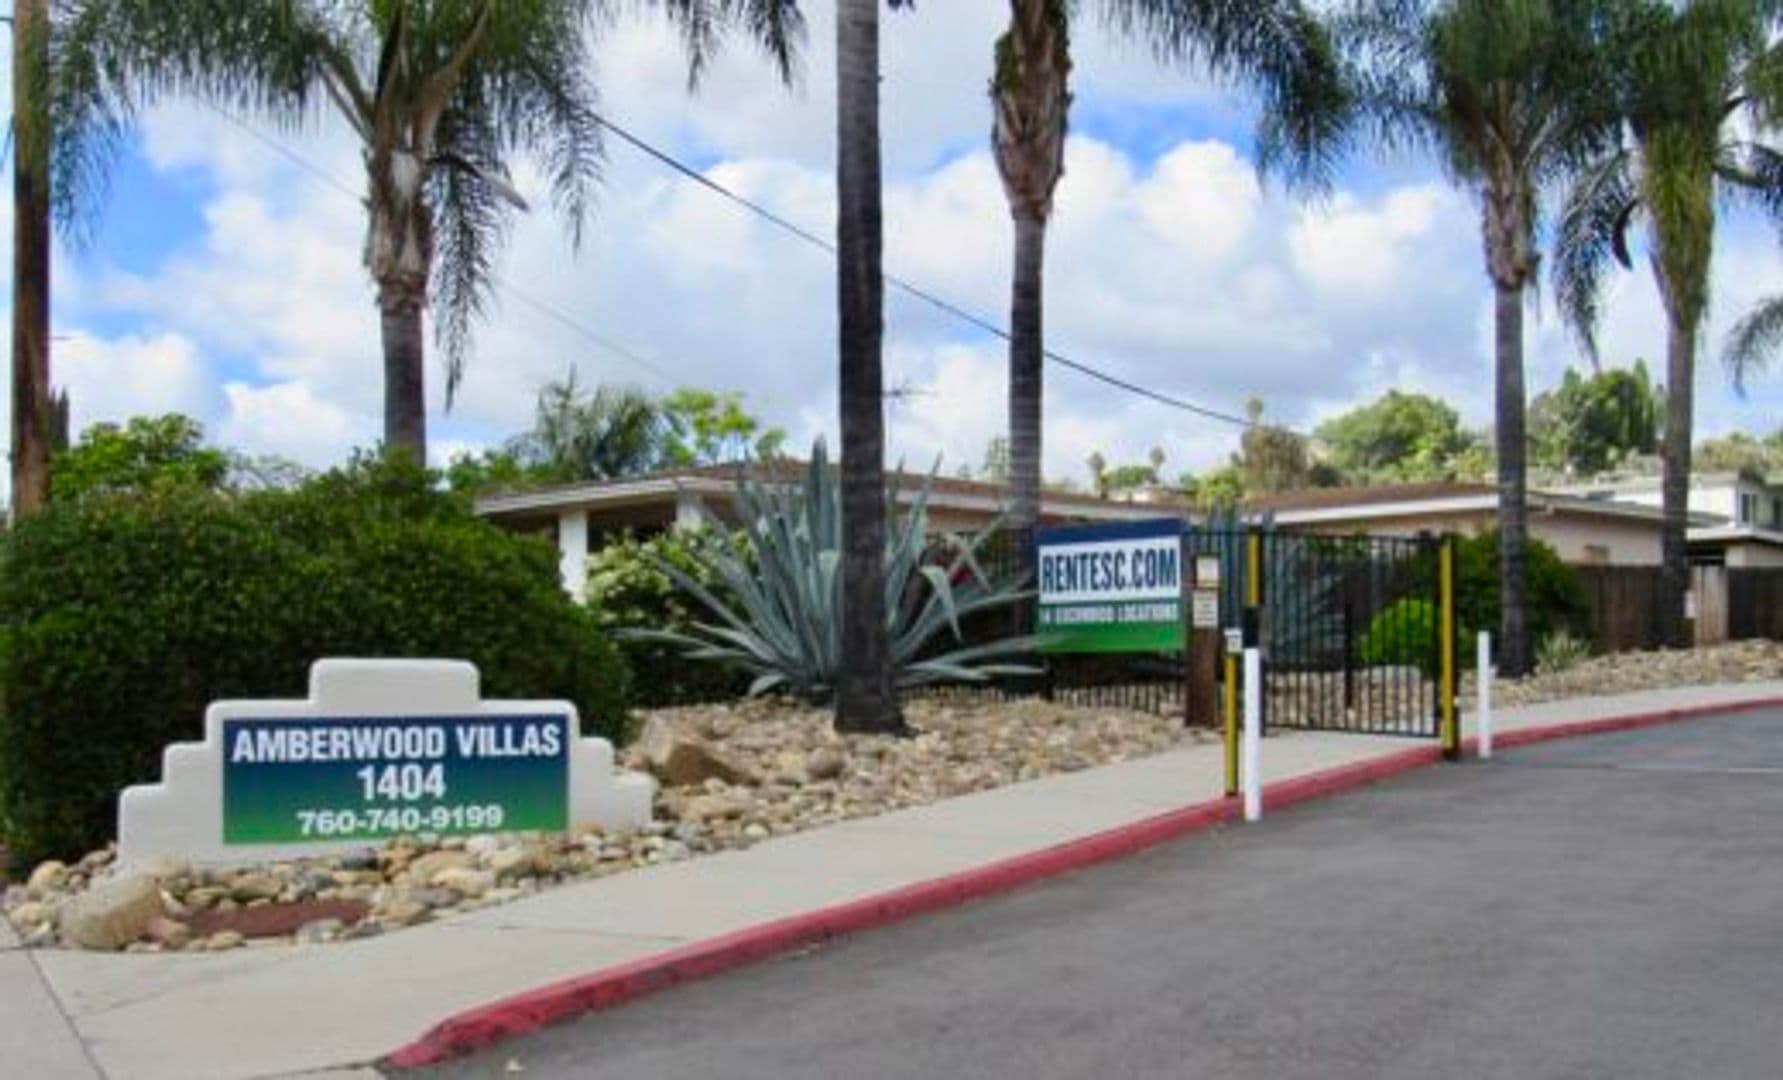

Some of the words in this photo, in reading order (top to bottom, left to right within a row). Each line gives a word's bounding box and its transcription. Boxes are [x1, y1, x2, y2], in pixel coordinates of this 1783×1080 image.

[1042, 549, 1177, 593] RENTESC.COM
[232, 726, 445, 762] AMBERWOOD
[455, 724, 560, 756] VILLAS
[356, 764, 446, 800] 1404
[297, 804, 504, 835] 760-740-9199
